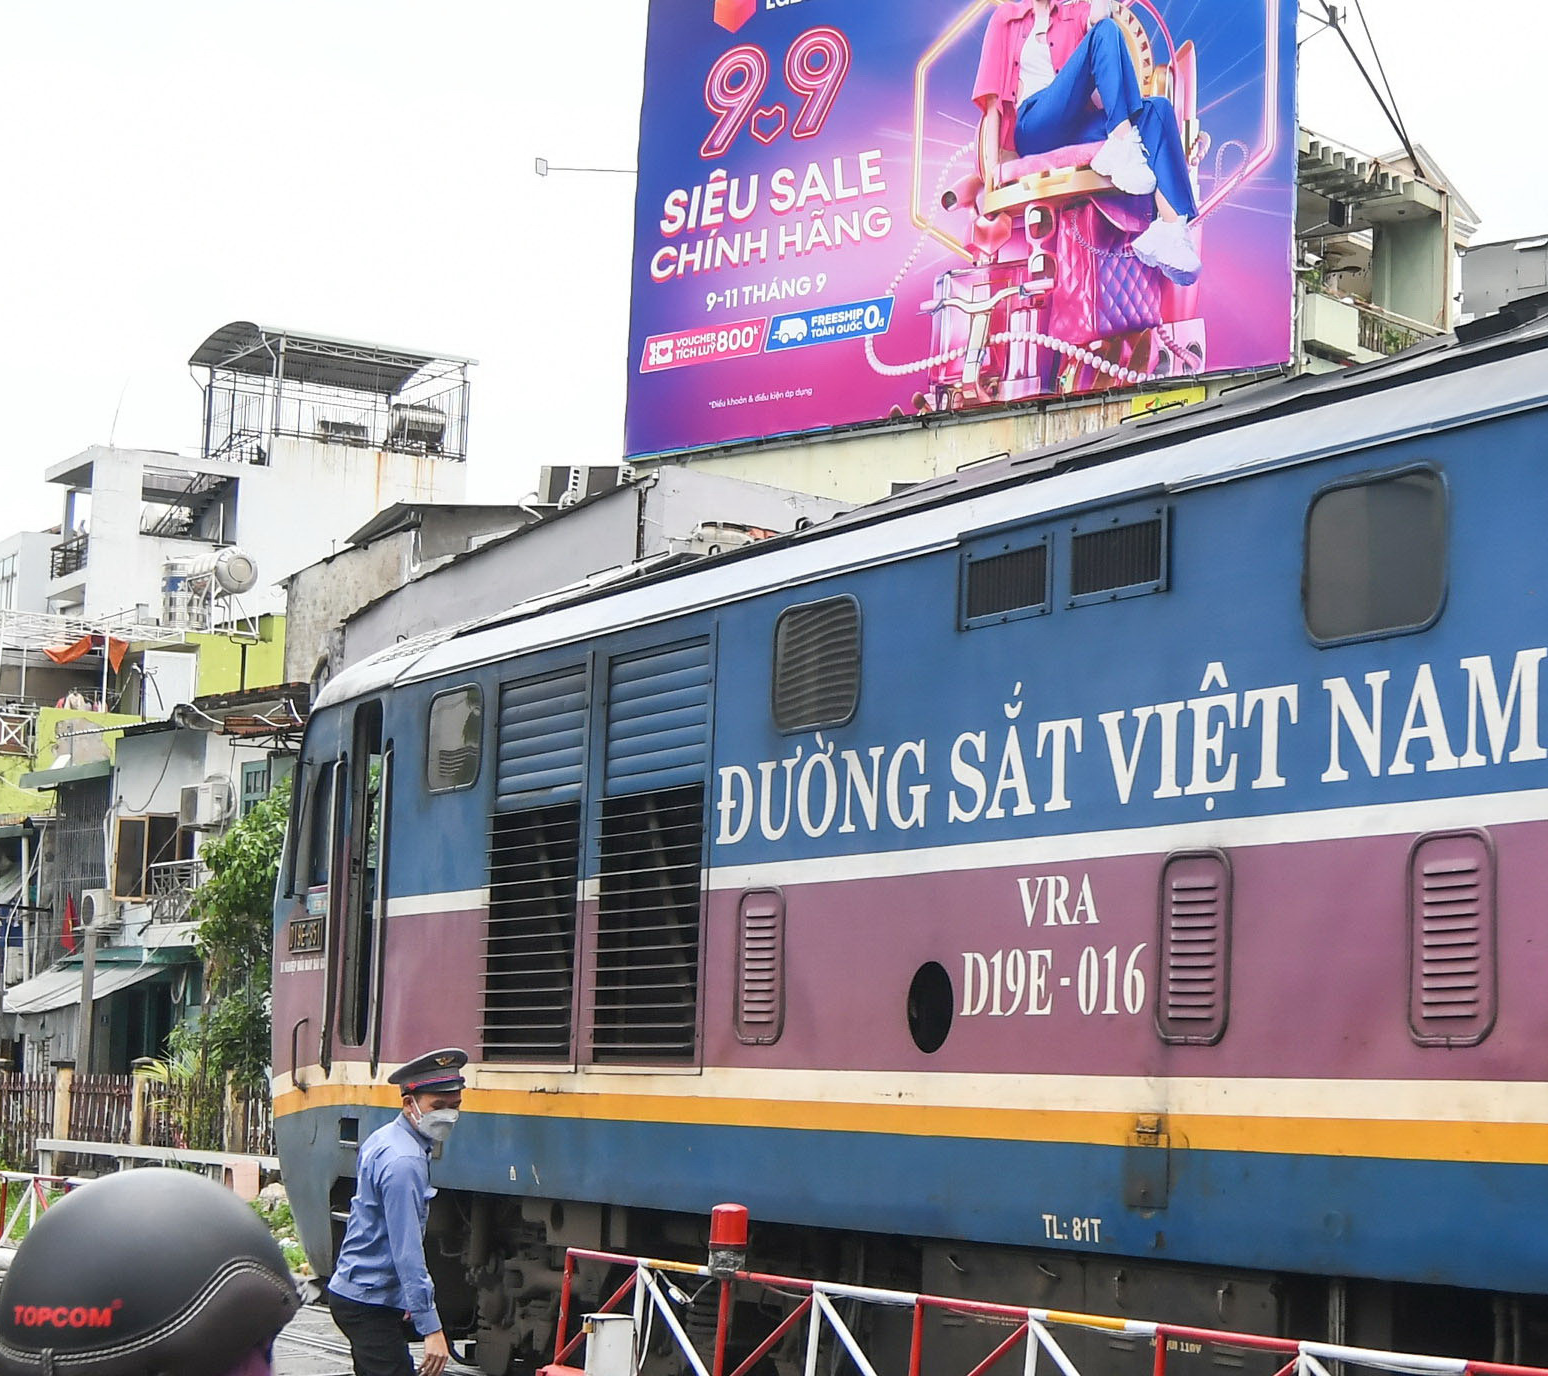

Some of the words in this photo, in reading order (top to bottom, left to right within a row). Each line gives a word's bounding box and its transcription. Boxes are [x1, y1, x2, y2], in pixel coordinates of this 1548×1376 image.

[660, 168, 760, 236] SIÊU
[769, 149, 887, 215] SALE
[650, 229, 768, 281] CHÍNH
[778, 207, 892, 259] HÃNG
[705, 289, 739, 312] 9-11
[742, 276, 812, 305] THÁNG
[815, 273, 828, 293] 9
[810, 308, 864, 328] FREESHIP
[810, 325, 835, 339] TOÀN
[836, 319, 863, 335] QUỐC
[675, 332, 717, 348] VOUCHER
[675, 347, 697, 361] TÍCH
[716, 731, 931, 846] ĐƯỜNG
[947, 680, 1083, 824] SẮT
[1098, 661, 1301, 812] VIỆT
[1320, 646, 1548, 783] NAM
[1017, 873, 1100, 928] VRA
[1041, 1213, 1069, 1240] TL:
[1072, 1216, 1102, 1243] 81T
[14, 1305, 113, 1328] TOPCOM
